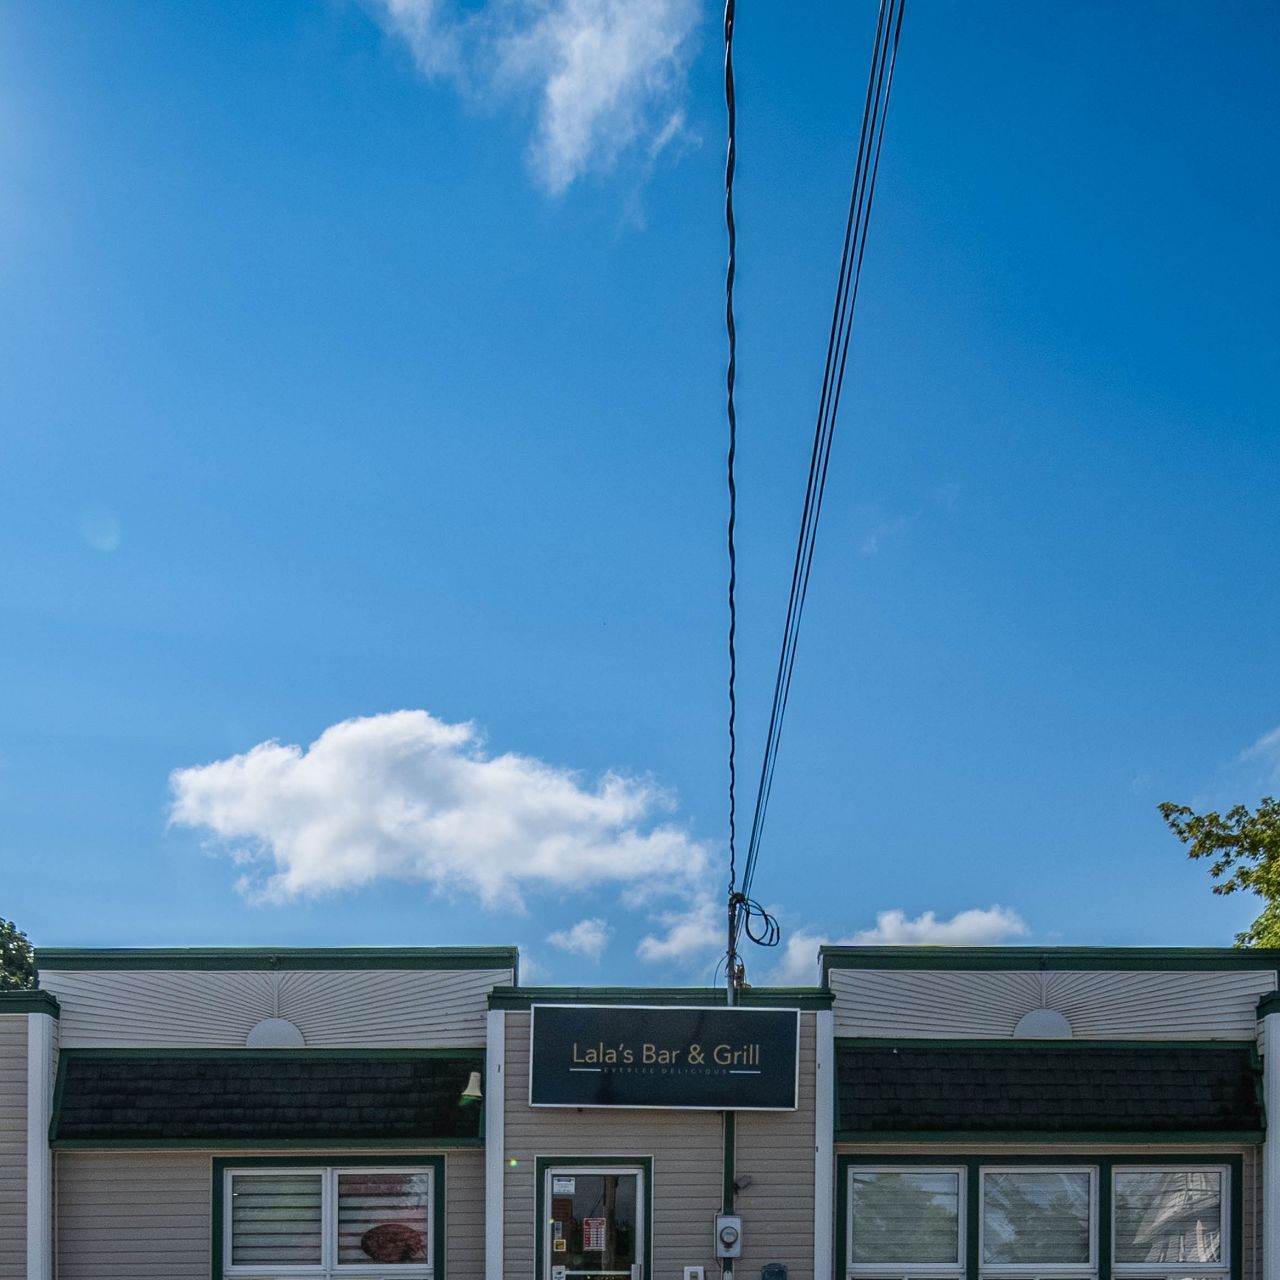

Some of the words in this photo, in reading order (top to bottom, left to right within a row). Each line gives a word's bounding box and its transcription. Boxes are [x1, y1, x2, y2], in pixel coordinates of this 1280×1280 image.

[573, 1042, 634, 1064] Lala's
[642, 1043, 680, 1065] Bar
[687, 1043, 705, 1066] &
[713, 1044, 760, 1066] Grill
